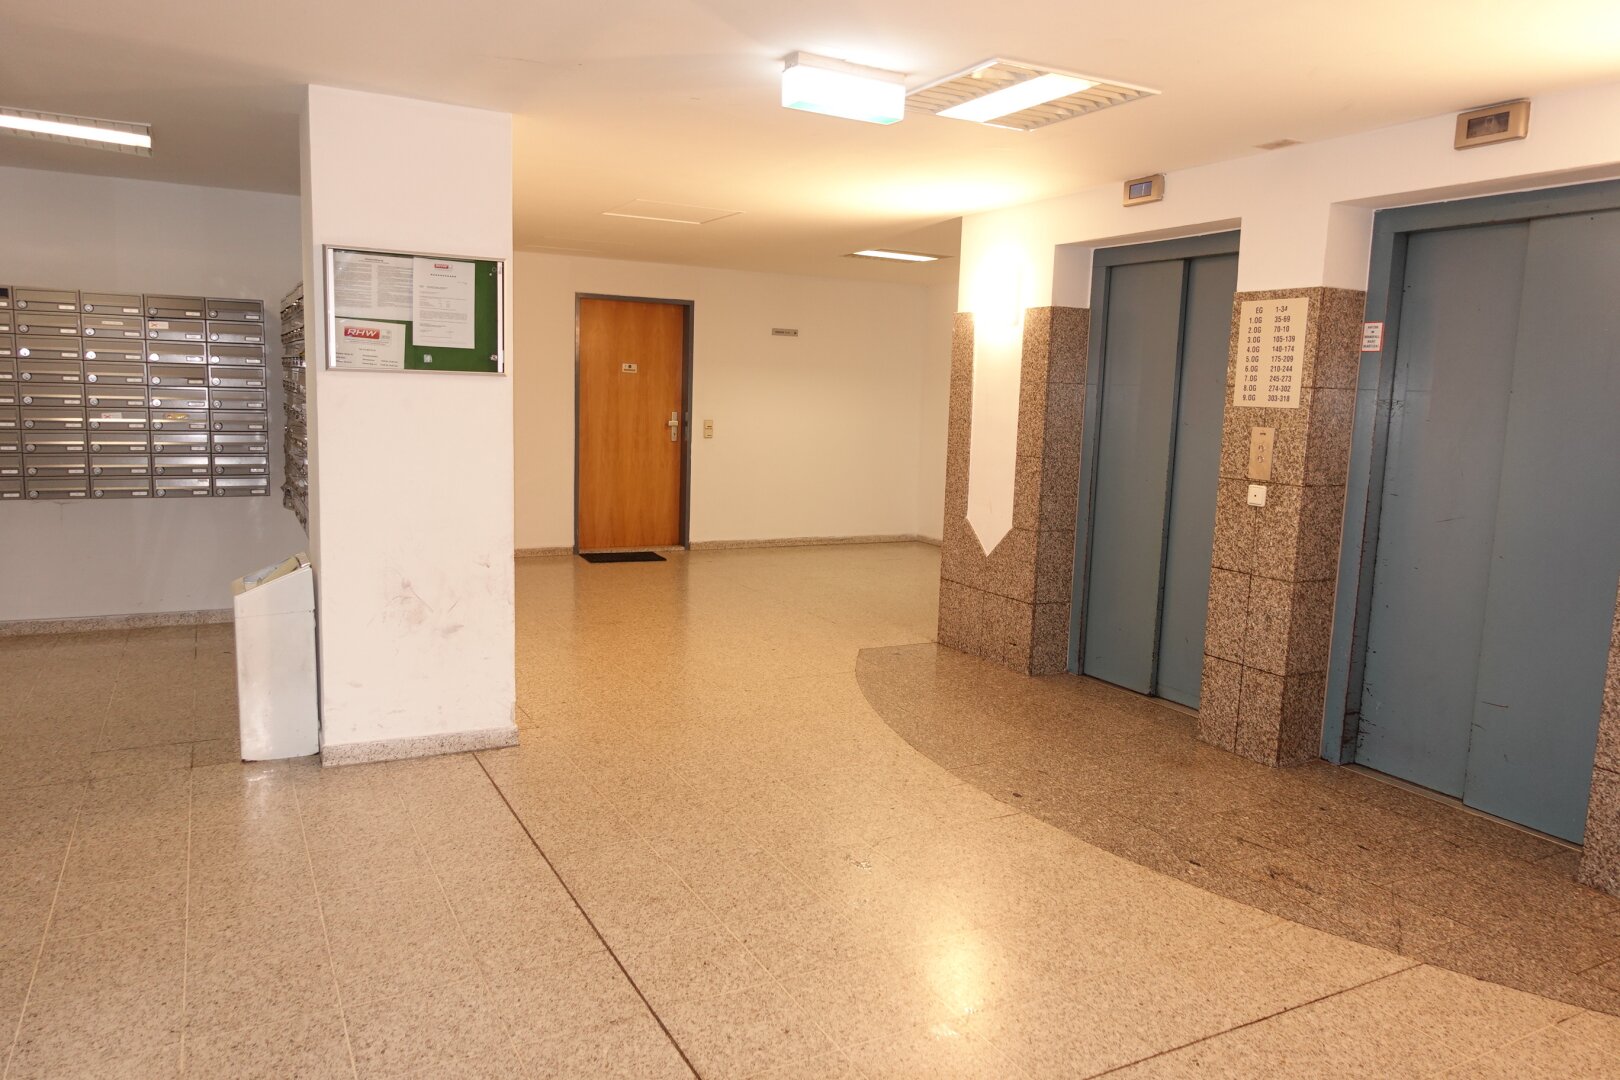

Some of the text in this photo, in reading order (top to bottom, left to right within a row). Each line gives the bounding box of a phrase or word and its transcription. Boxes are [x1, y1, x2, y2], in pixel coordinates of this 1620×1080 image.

[1255, 305, 1288, 314] EG 1-34
[1249, 315, 1291, 324] 1.OG 35-69
[347, 328, 377, 337] RHW
[1273, 325, 1290, 333] 70-10
[1247, 335, 1296, 344] 3.OG 105-139
[1272, 345, 1295, 353] 140-174
[1245, 355, 1259, 363] 5.OG
[1269, 375, 1292, 383] 245-273
[1243, 384, 1257, 392] 8.OG
[1267, 394, 1290, 402] 303-318
